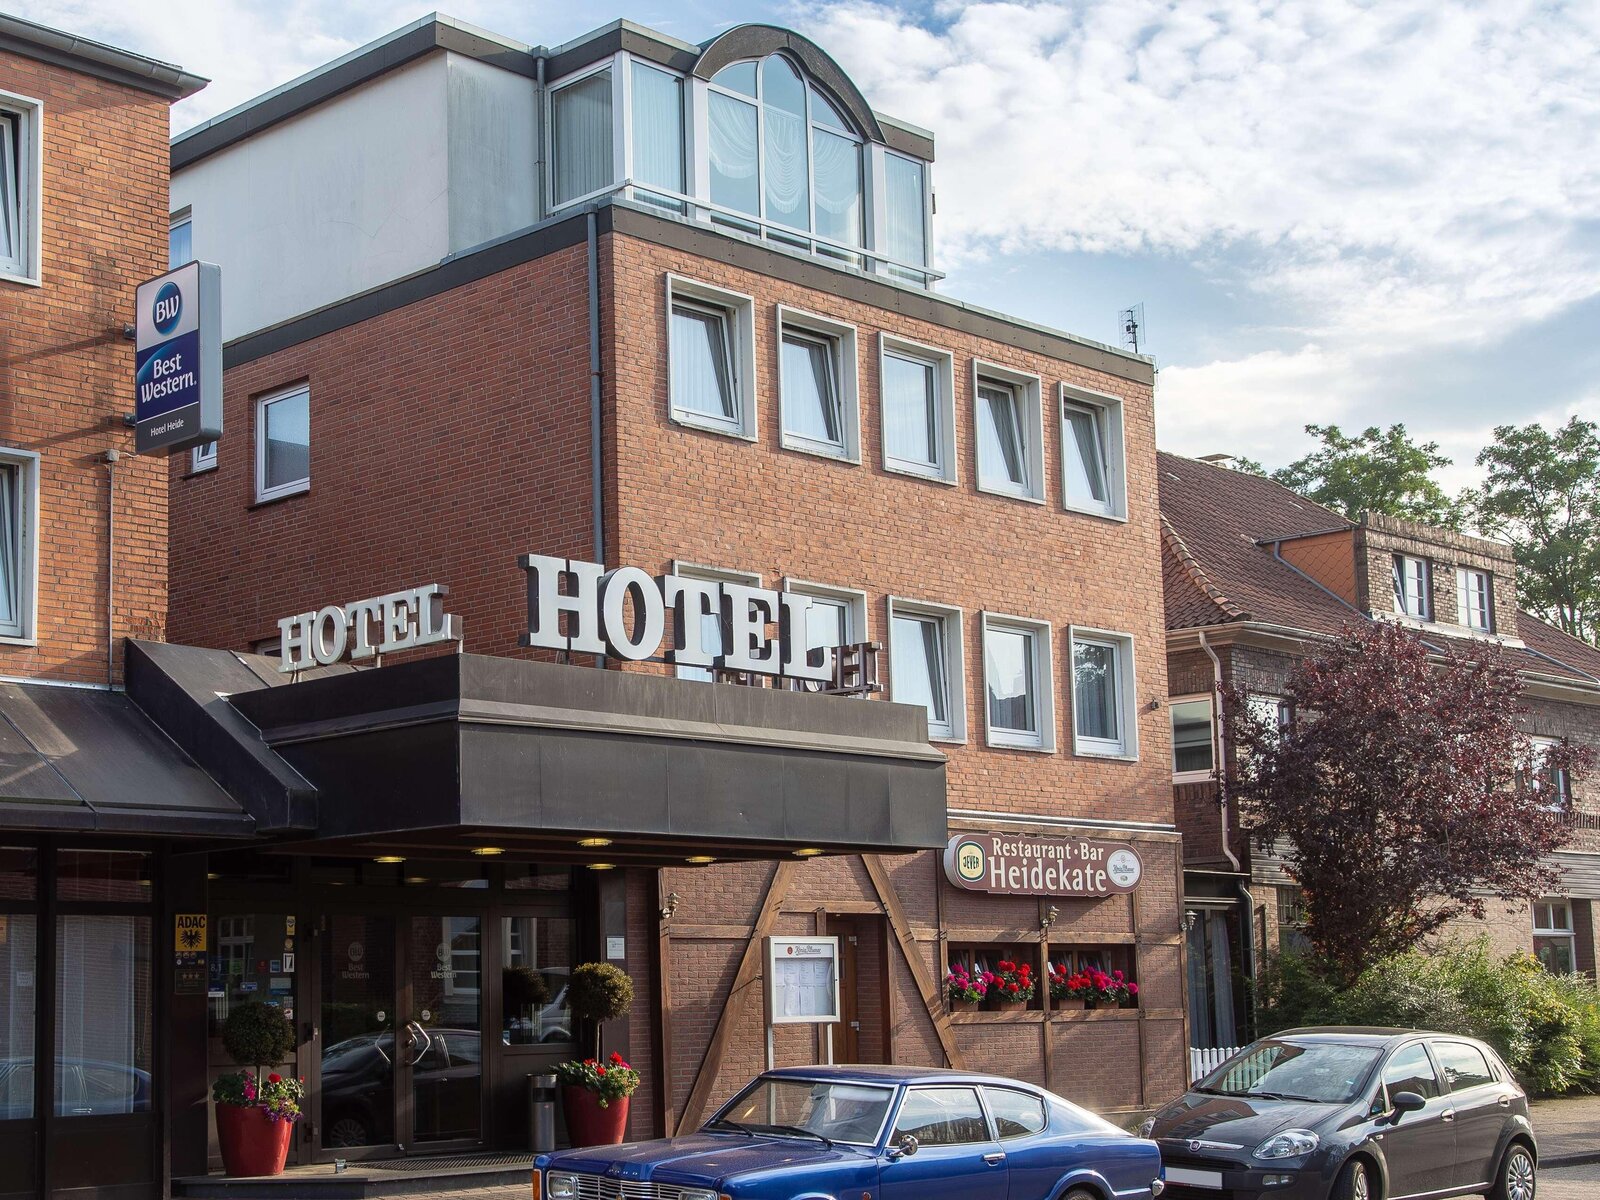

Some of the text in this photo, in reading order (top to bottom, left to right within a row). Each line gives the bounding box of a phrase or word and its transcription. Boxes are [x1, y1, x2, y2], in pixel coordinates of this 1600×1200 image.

[156, 294, 180, 324] BW
[153, 353, 182, 379] Best
[140, 371, 195, 404] Western
[150, 418, 185, 437] Hotel Heide
[518, 553, 832, 681] HOTEL
[277, 583, 454, 674] HOTEL
[992, 837, 1105, 861] Restaurant Bar
[963, 855, 980, 870] JEVER
[988, 856, 1107, 892] Heidekate
[177, 916, 206, 929] ADAC
[342, 971, 370, 979] Western
[348, 963, 364, 971] Best
[431, 971, 457, 979] Western
[437, 963, 452, 971] Best
